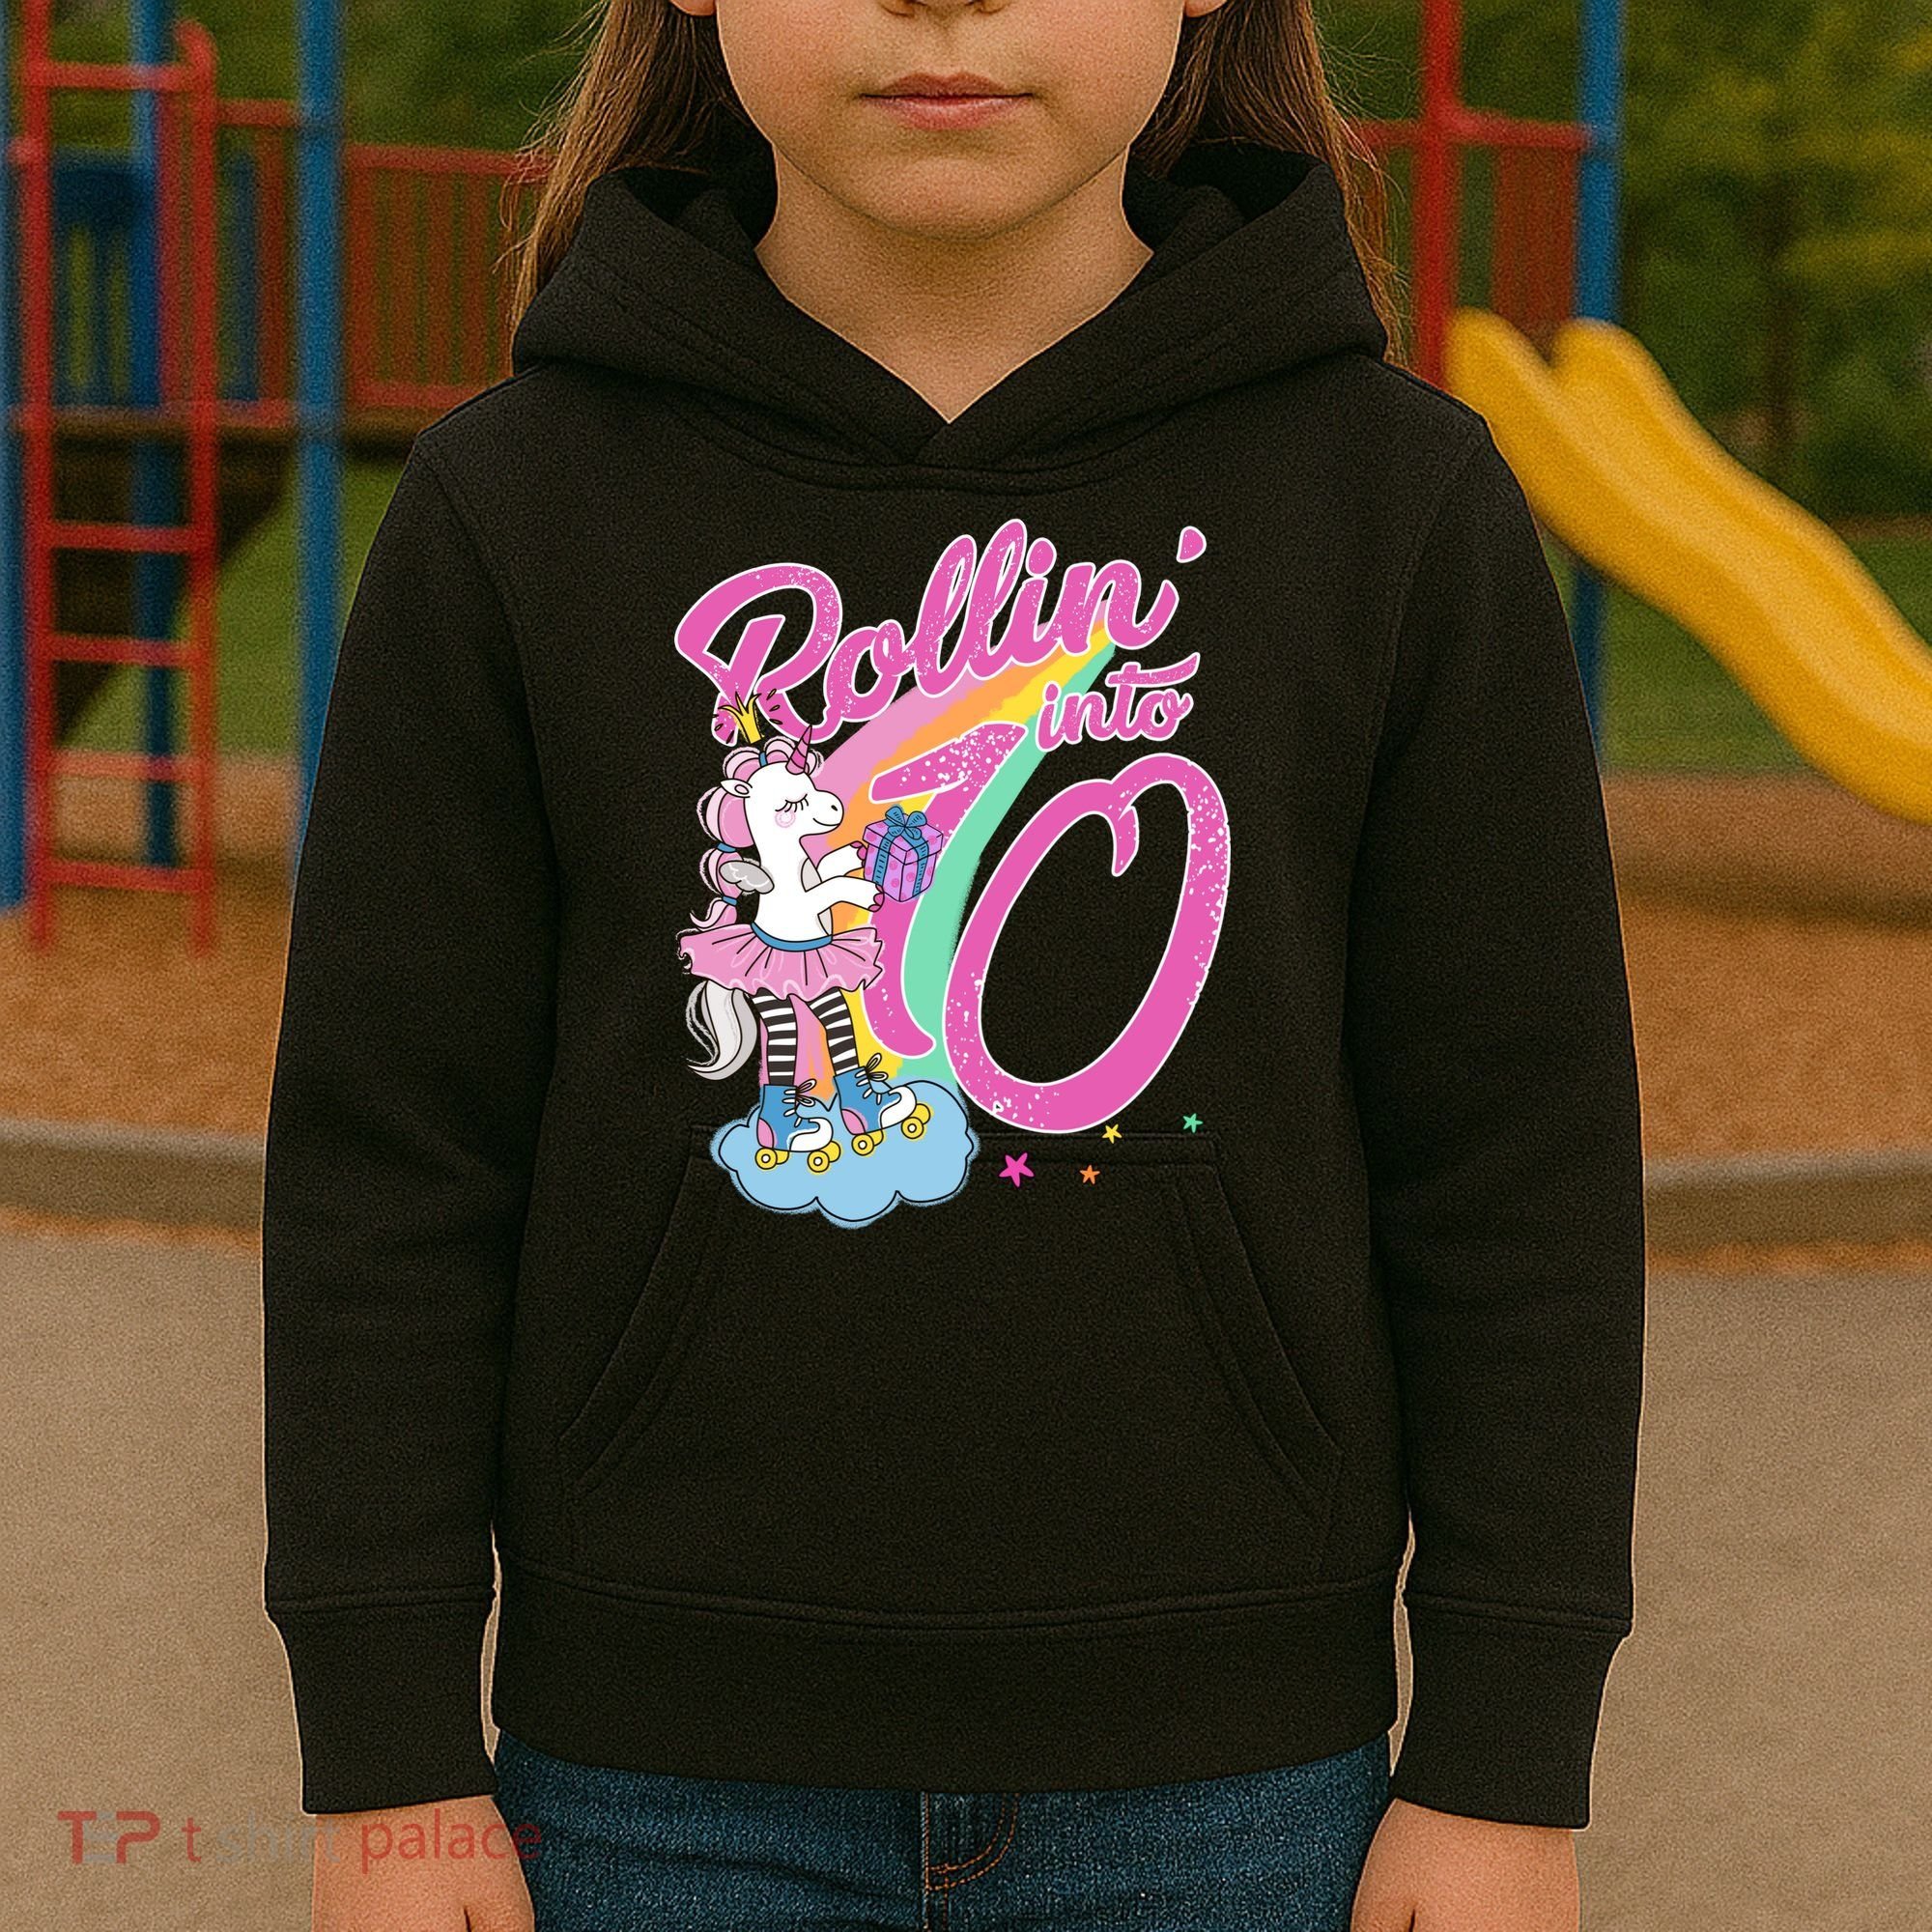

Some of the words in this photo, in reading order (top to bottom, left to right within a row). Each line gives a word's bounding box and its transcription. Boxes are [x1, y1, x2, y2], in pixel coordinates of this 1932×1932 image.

[675, 519, 1208, 747] Rollin'
[1037, 652, 1201, 751] into
[862, 722, 1232, 1133] 10
